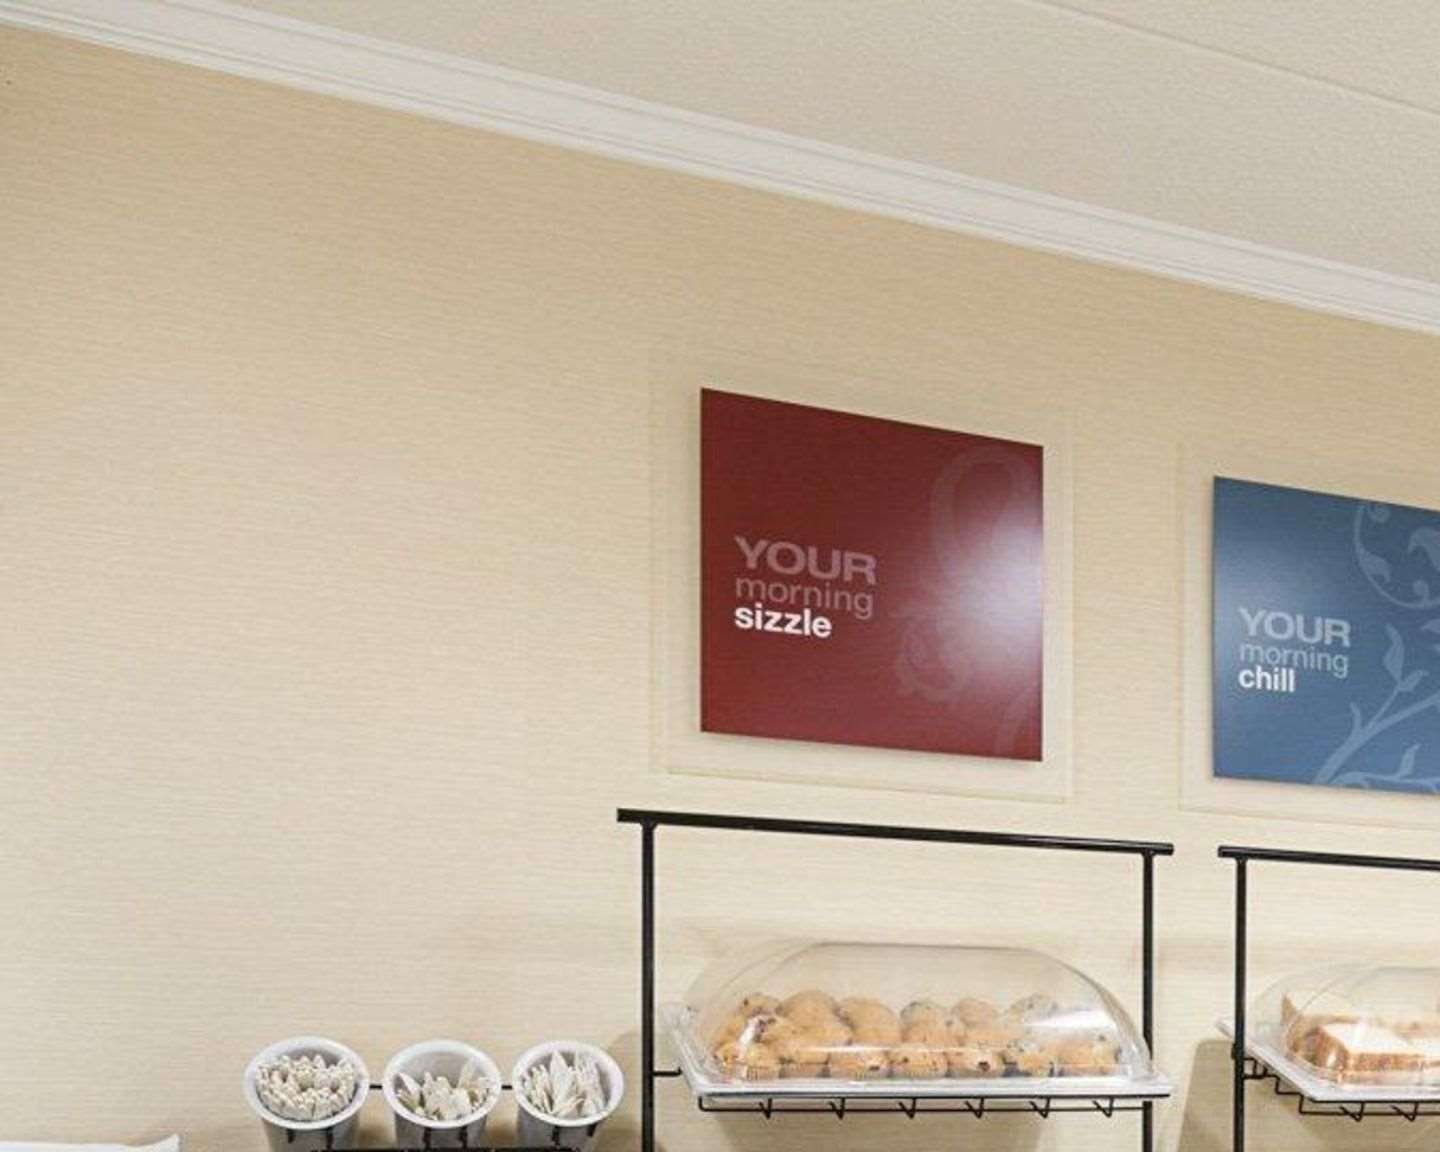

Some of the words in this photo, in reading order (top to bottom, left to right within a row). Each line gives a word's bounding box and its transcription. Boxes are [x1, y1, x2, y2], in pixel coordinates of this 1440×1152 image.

[735, 536, 876, 584] YOUR
[736, 577, 873, 620] morning
[735, 603, 832, 638] sizzle
[1238, 607, 1351, 647] YOUR
[1238, 665, 1295, 692] chill
[1239, 644, 1349, 679] morning
